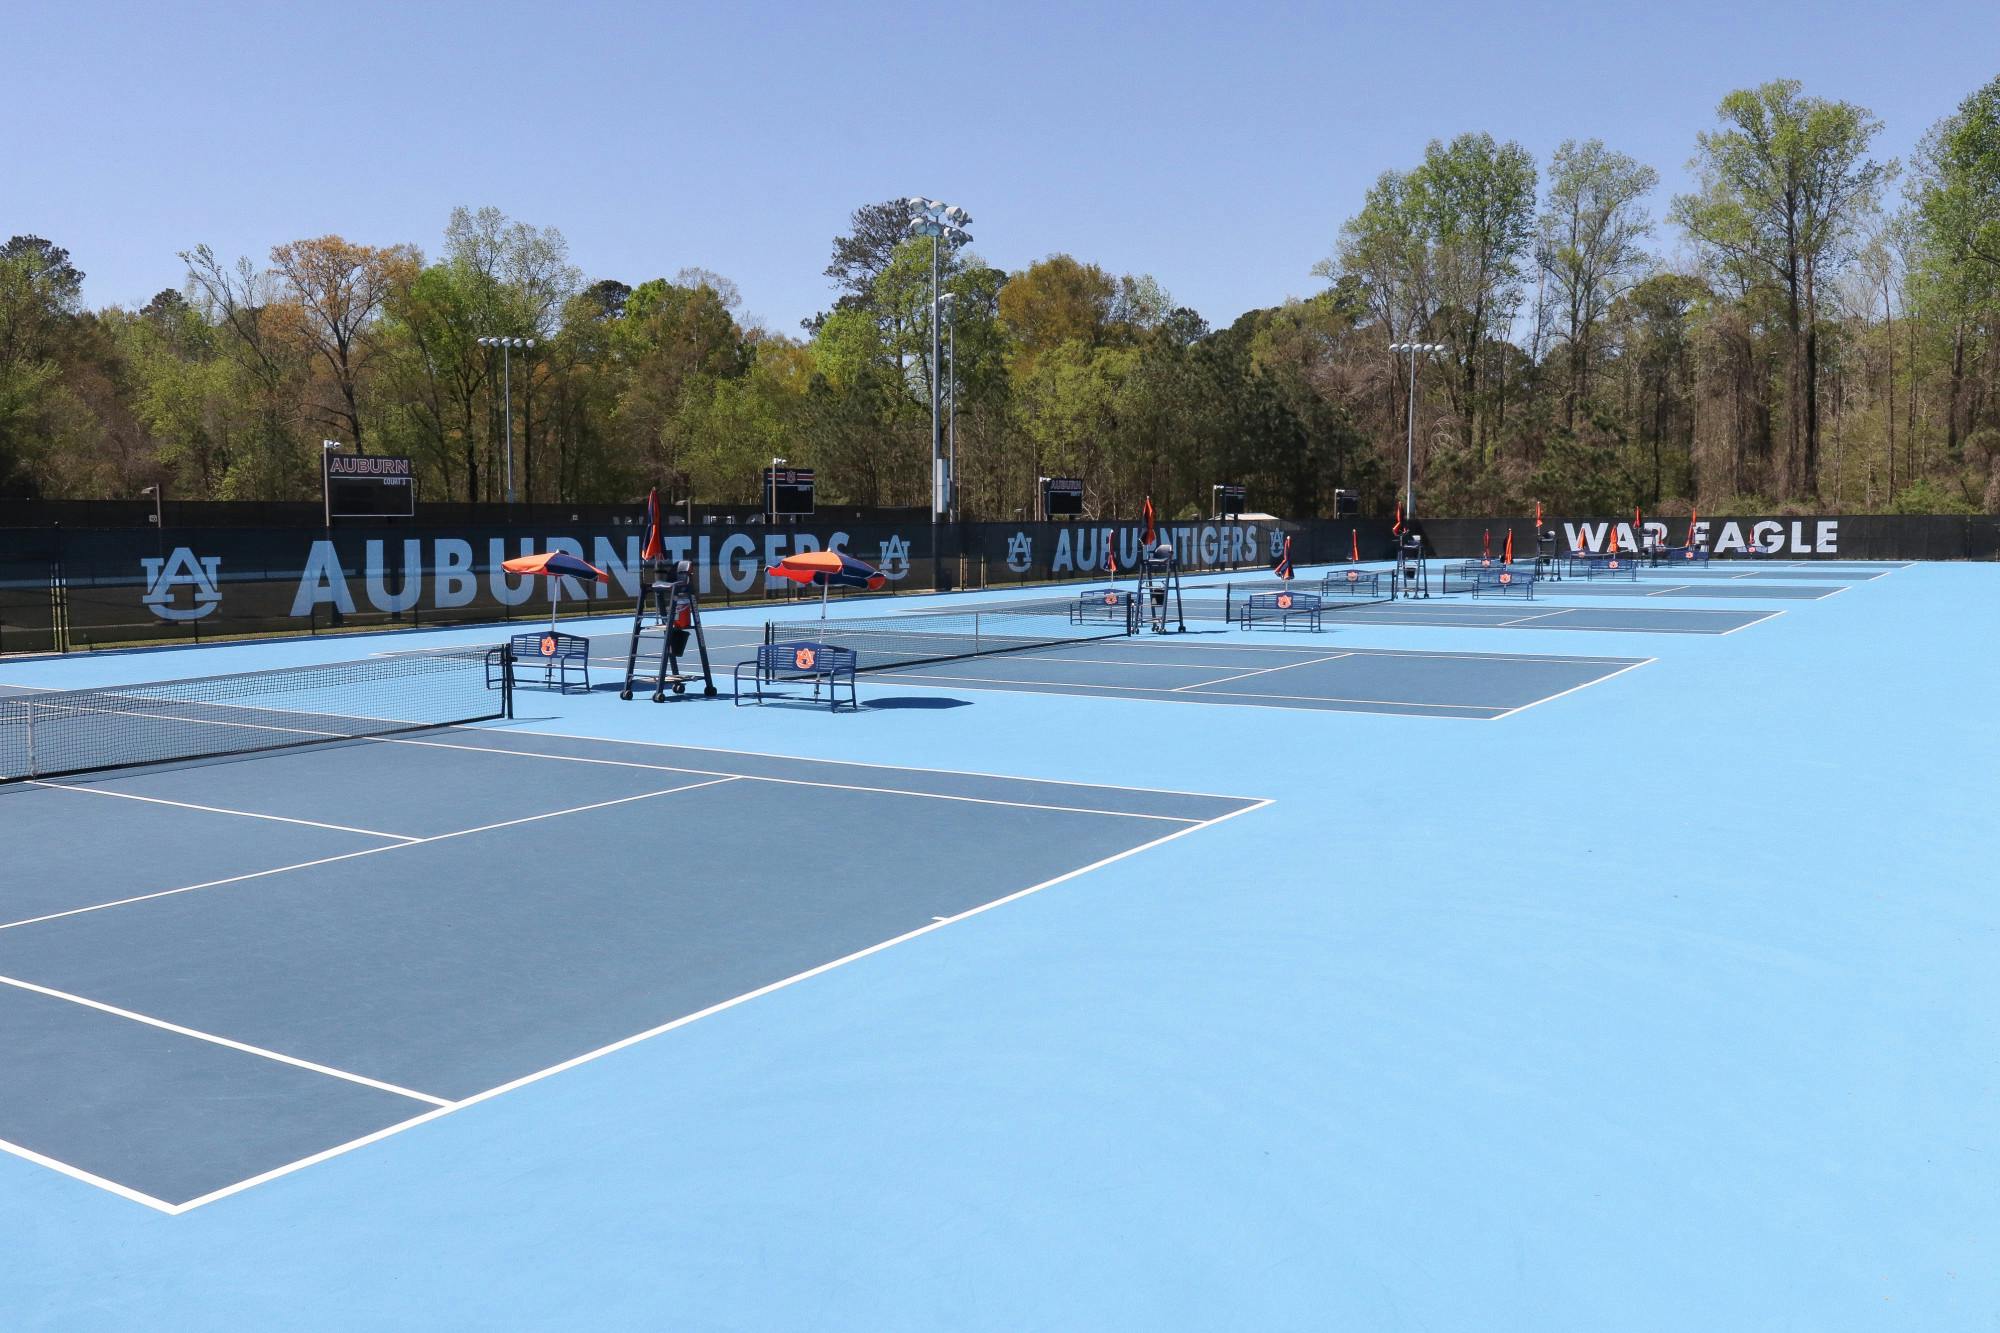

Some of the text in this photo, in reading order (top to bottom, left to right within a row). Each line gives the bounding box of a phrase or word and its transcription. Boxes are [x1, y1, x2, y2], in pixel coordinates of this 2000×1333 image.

[330, 458, 408, 474] AUBURN
[1178, 525, 1257, 567] TIGERS
[1563, 520, 1838, 553] WAR EAGLE
[290, 536, 641, 617] AUBURN
